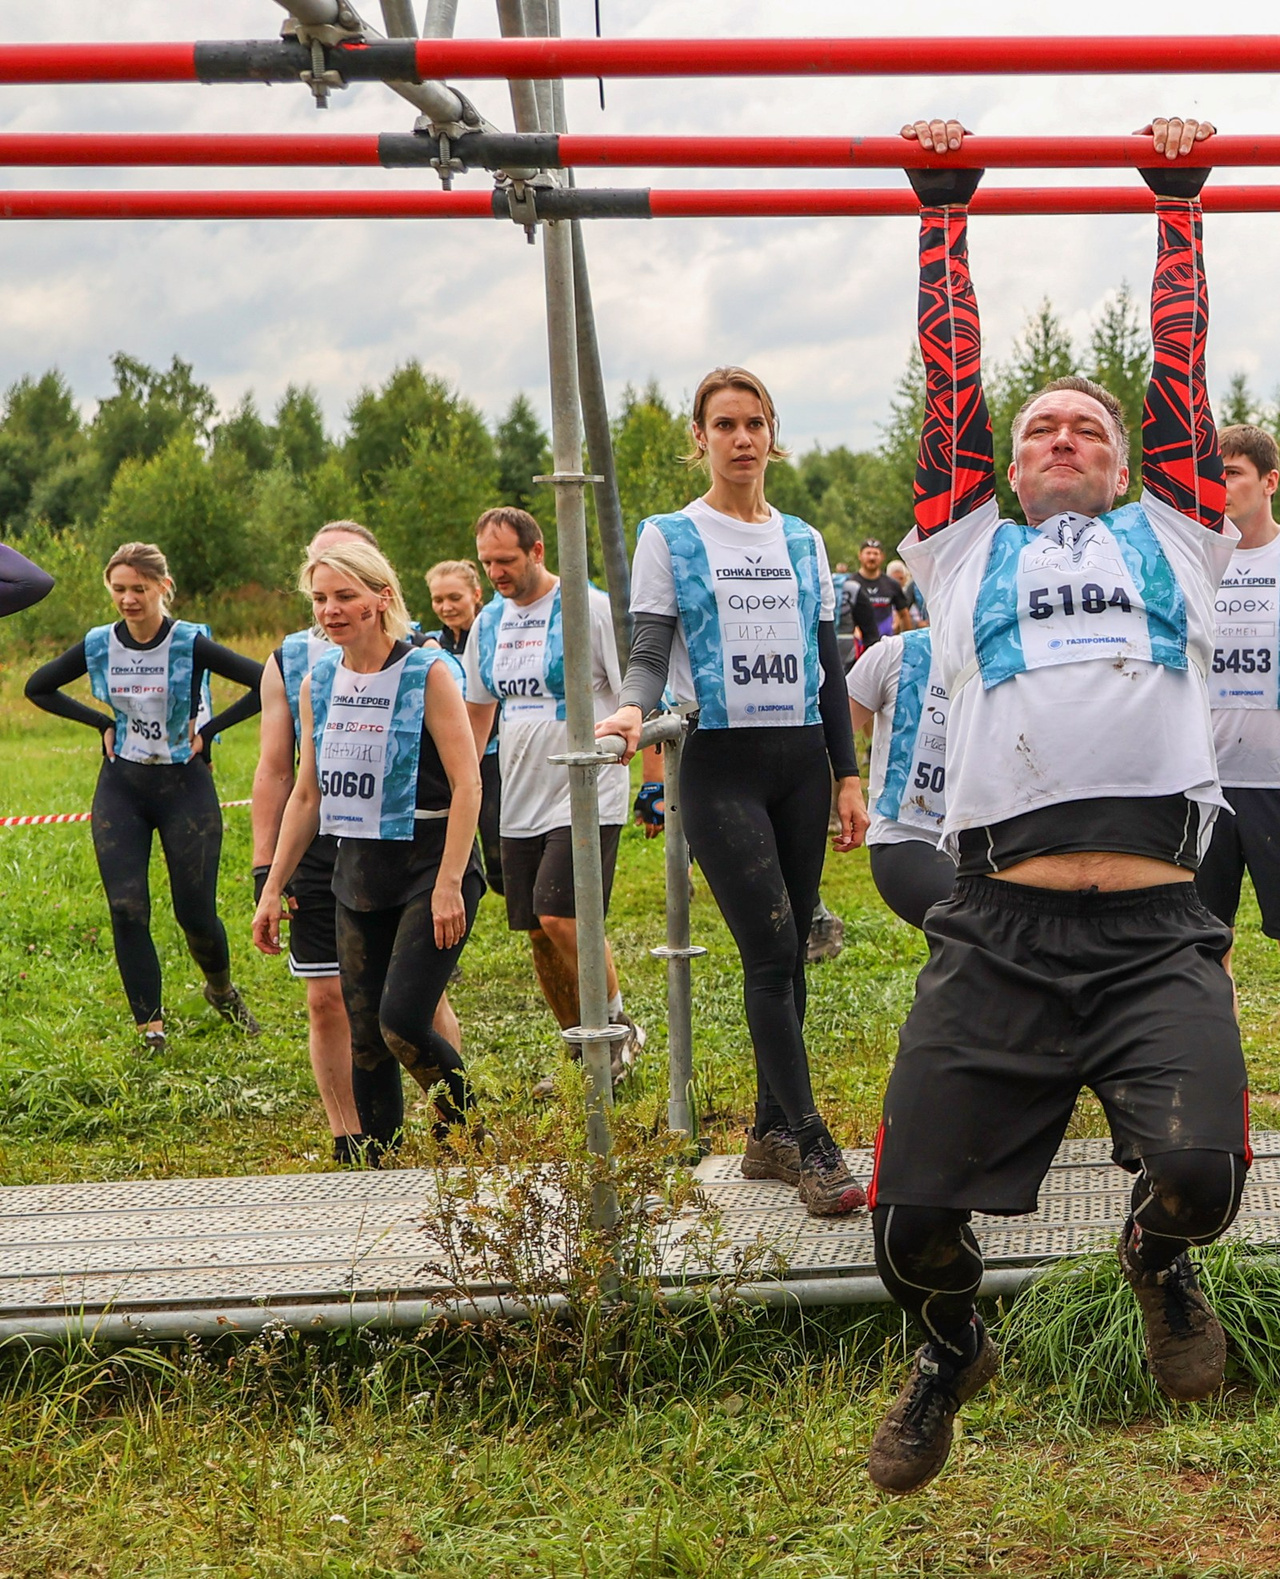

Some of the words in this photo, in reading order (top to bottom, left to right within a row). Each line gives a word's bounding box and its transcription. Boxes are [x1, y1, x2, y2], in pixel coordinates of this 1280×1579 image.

[716, 568, 752, 577] ГОНКА
[755, 568, 791, 577] ГЕРОЕВ
[1220, 578, 1239, 586] НКА
[1242, 577, 1276, 585] ГЕРОЕВ
[1029, 583, 1132, 620] 5184
[738, 624, 777, 640] ИРА
[1066, 637, 1128, 645] ГАЗПРОМБАНК
[731, 653, 798, 685] 5440
[1212, 648, 1271, 674] 5453
[136, 666, 165, 674] ГЕРОЕВ
[498, 678, 543, 697] 5072
[356, 697, 391, 706] ГЕРОЕВ
[326, 722, 344, 730] B2B
[321, 770, 376, 799] 5060
[914, 761, 945, 793] 50
